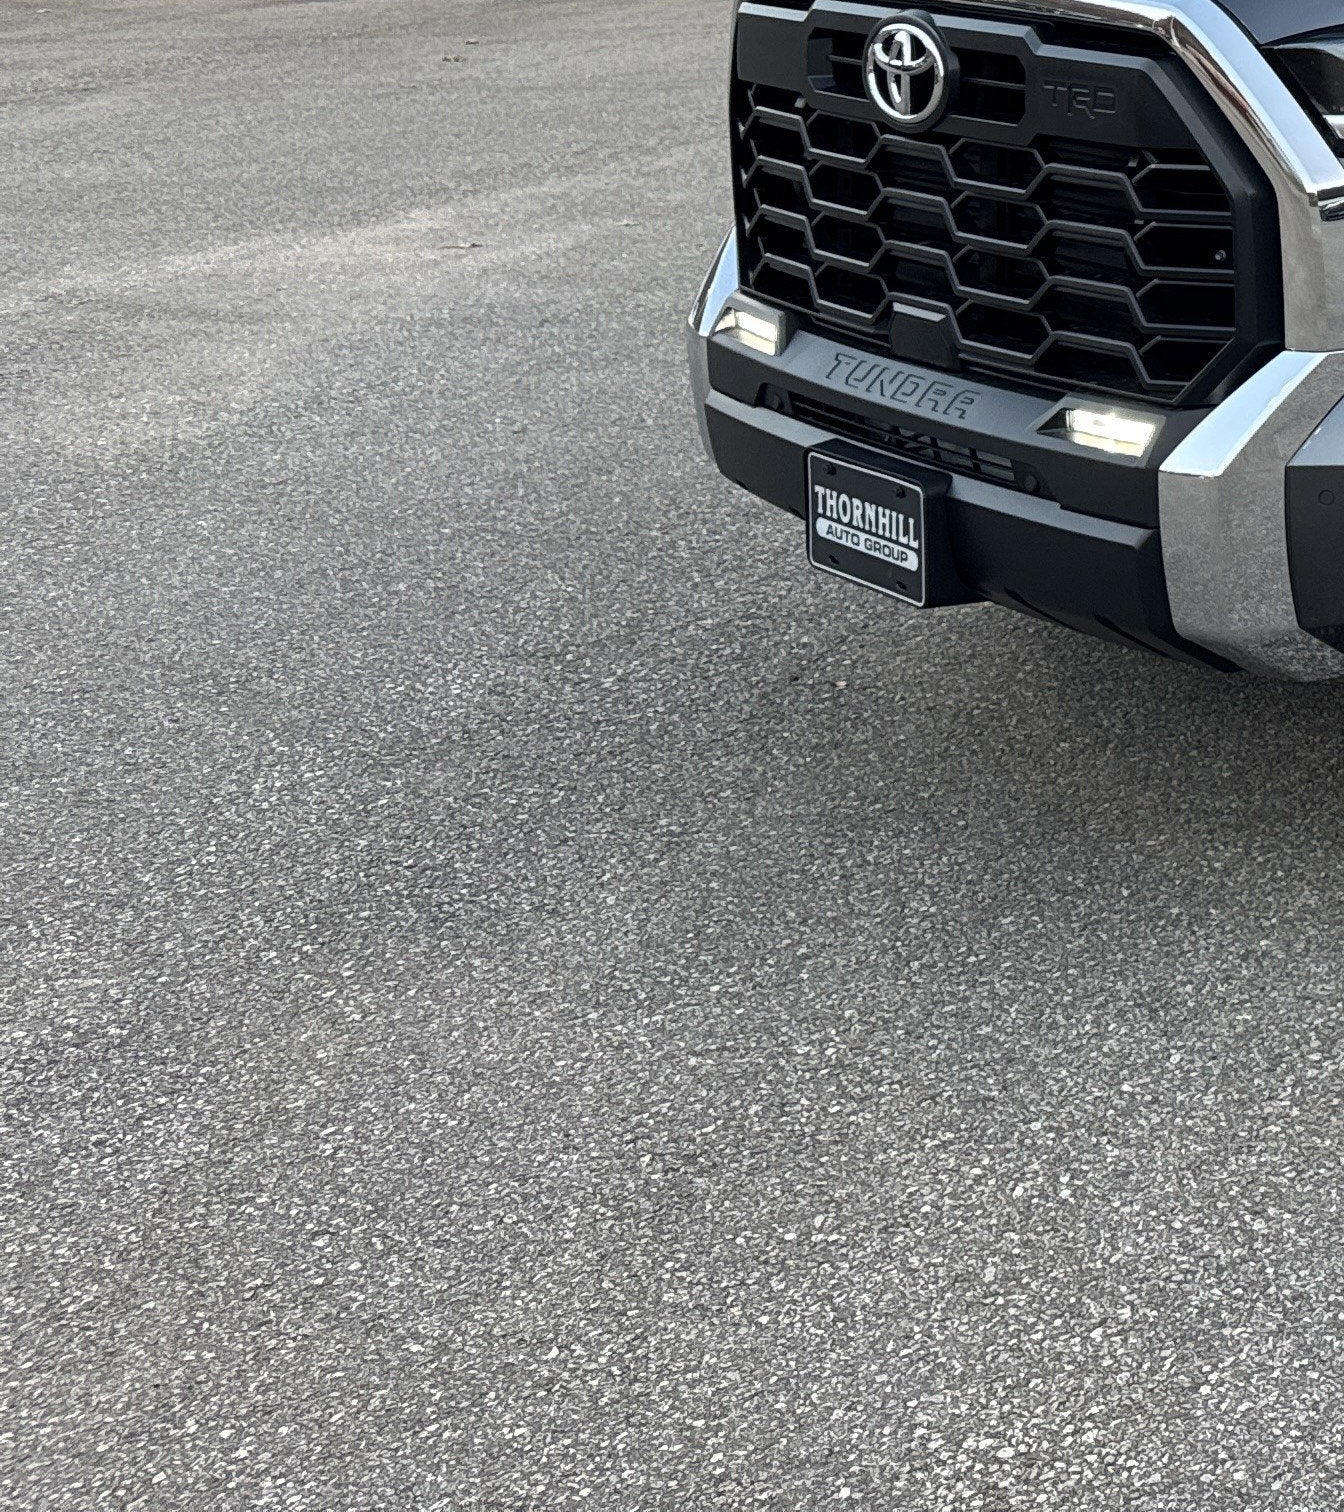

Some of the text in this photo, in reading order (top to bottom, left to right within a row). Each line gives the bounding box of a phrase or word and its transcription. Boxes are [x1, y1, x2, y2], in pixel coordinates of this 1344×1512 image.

[1042, 80, 1118, 119] TRD
[825, 352, 981, 420] TUNDRA
[814, 484, 919, 549] THORNHILL
[826, 523, 908, 564] AUTO GROUP
